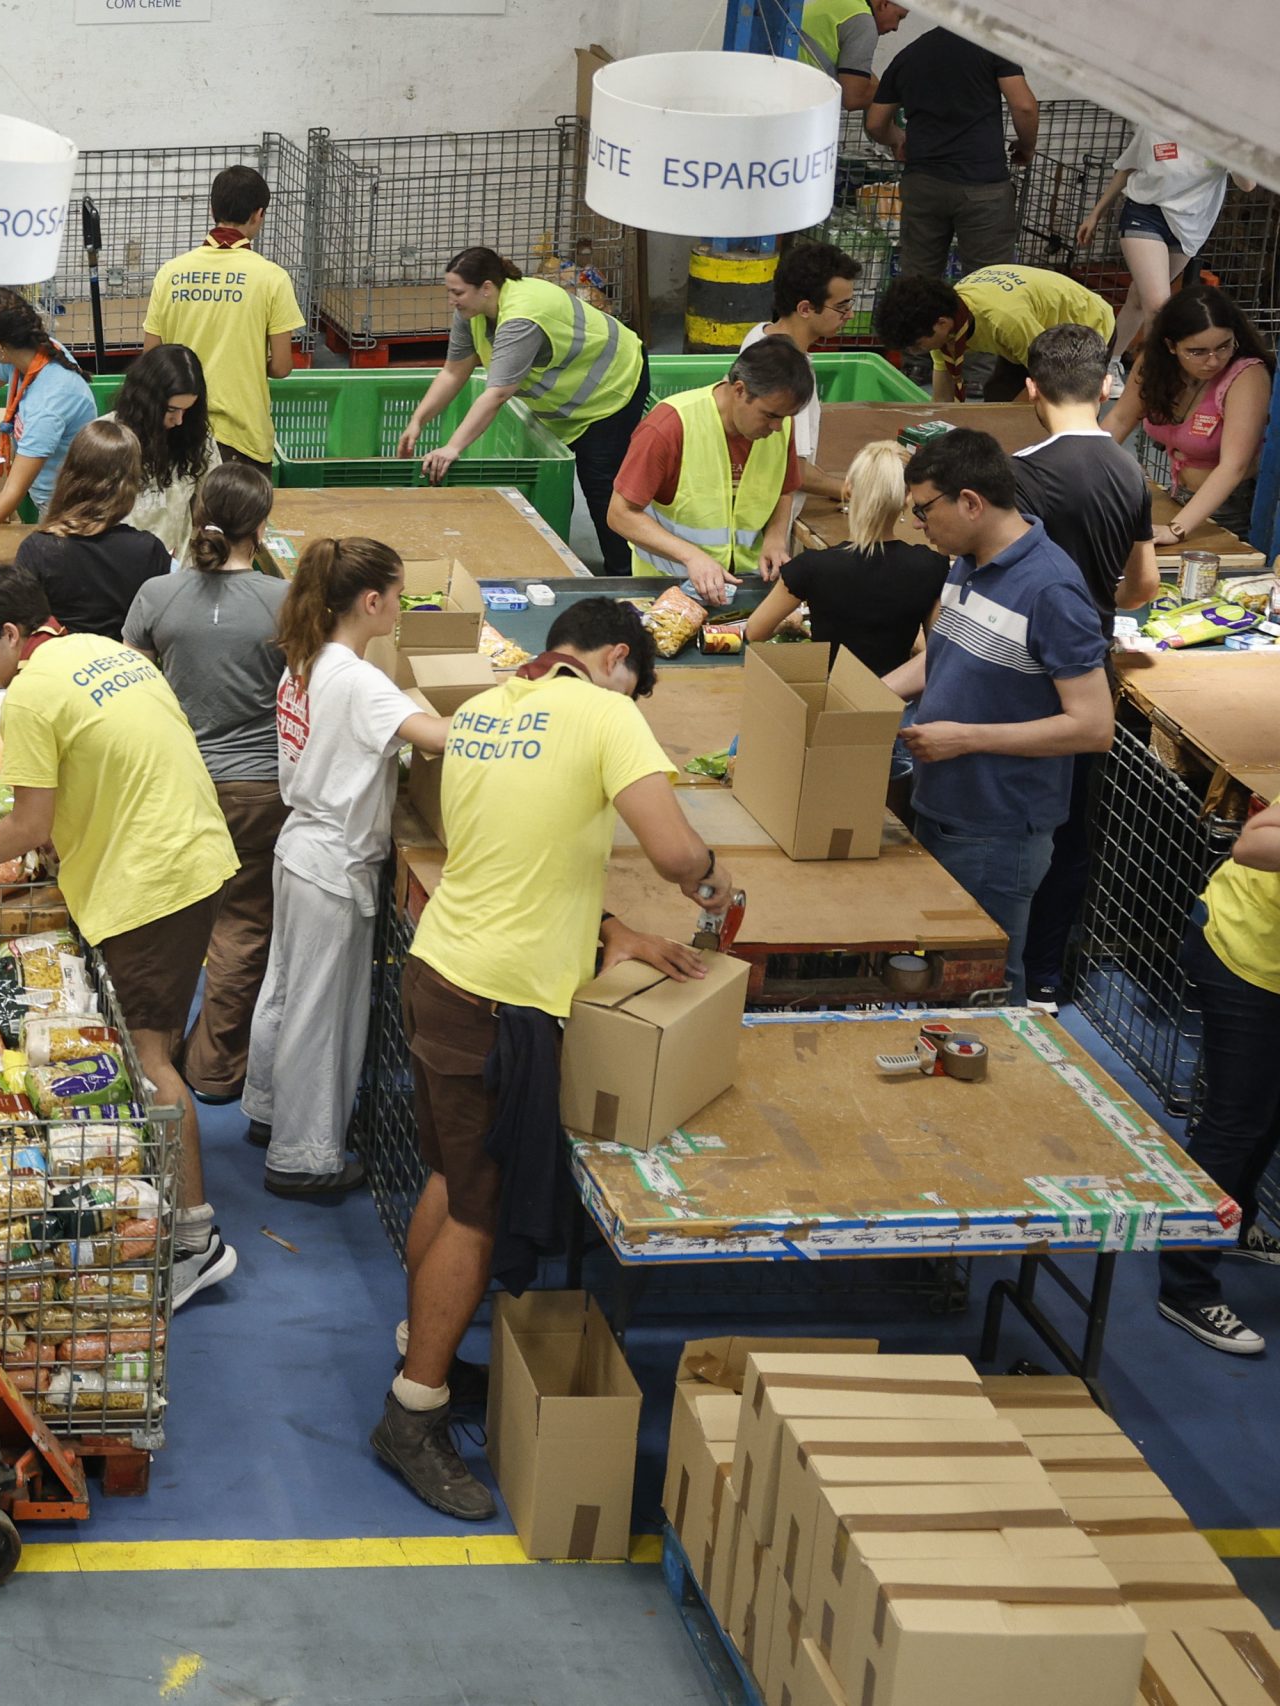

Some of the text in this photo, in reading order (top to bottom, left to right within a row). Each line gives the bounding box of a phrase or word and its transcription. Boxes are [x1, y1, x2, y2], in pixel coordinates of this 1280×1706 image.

[171, 271, 247, 286] CHEFE DE
[171, 289, 243, 303] PRODUTO
[72, 656, 125, 687] CHEFE
[90, 665, 158, 708] PRODUTO
[453, 711, 551, 735] CHEFE DE
